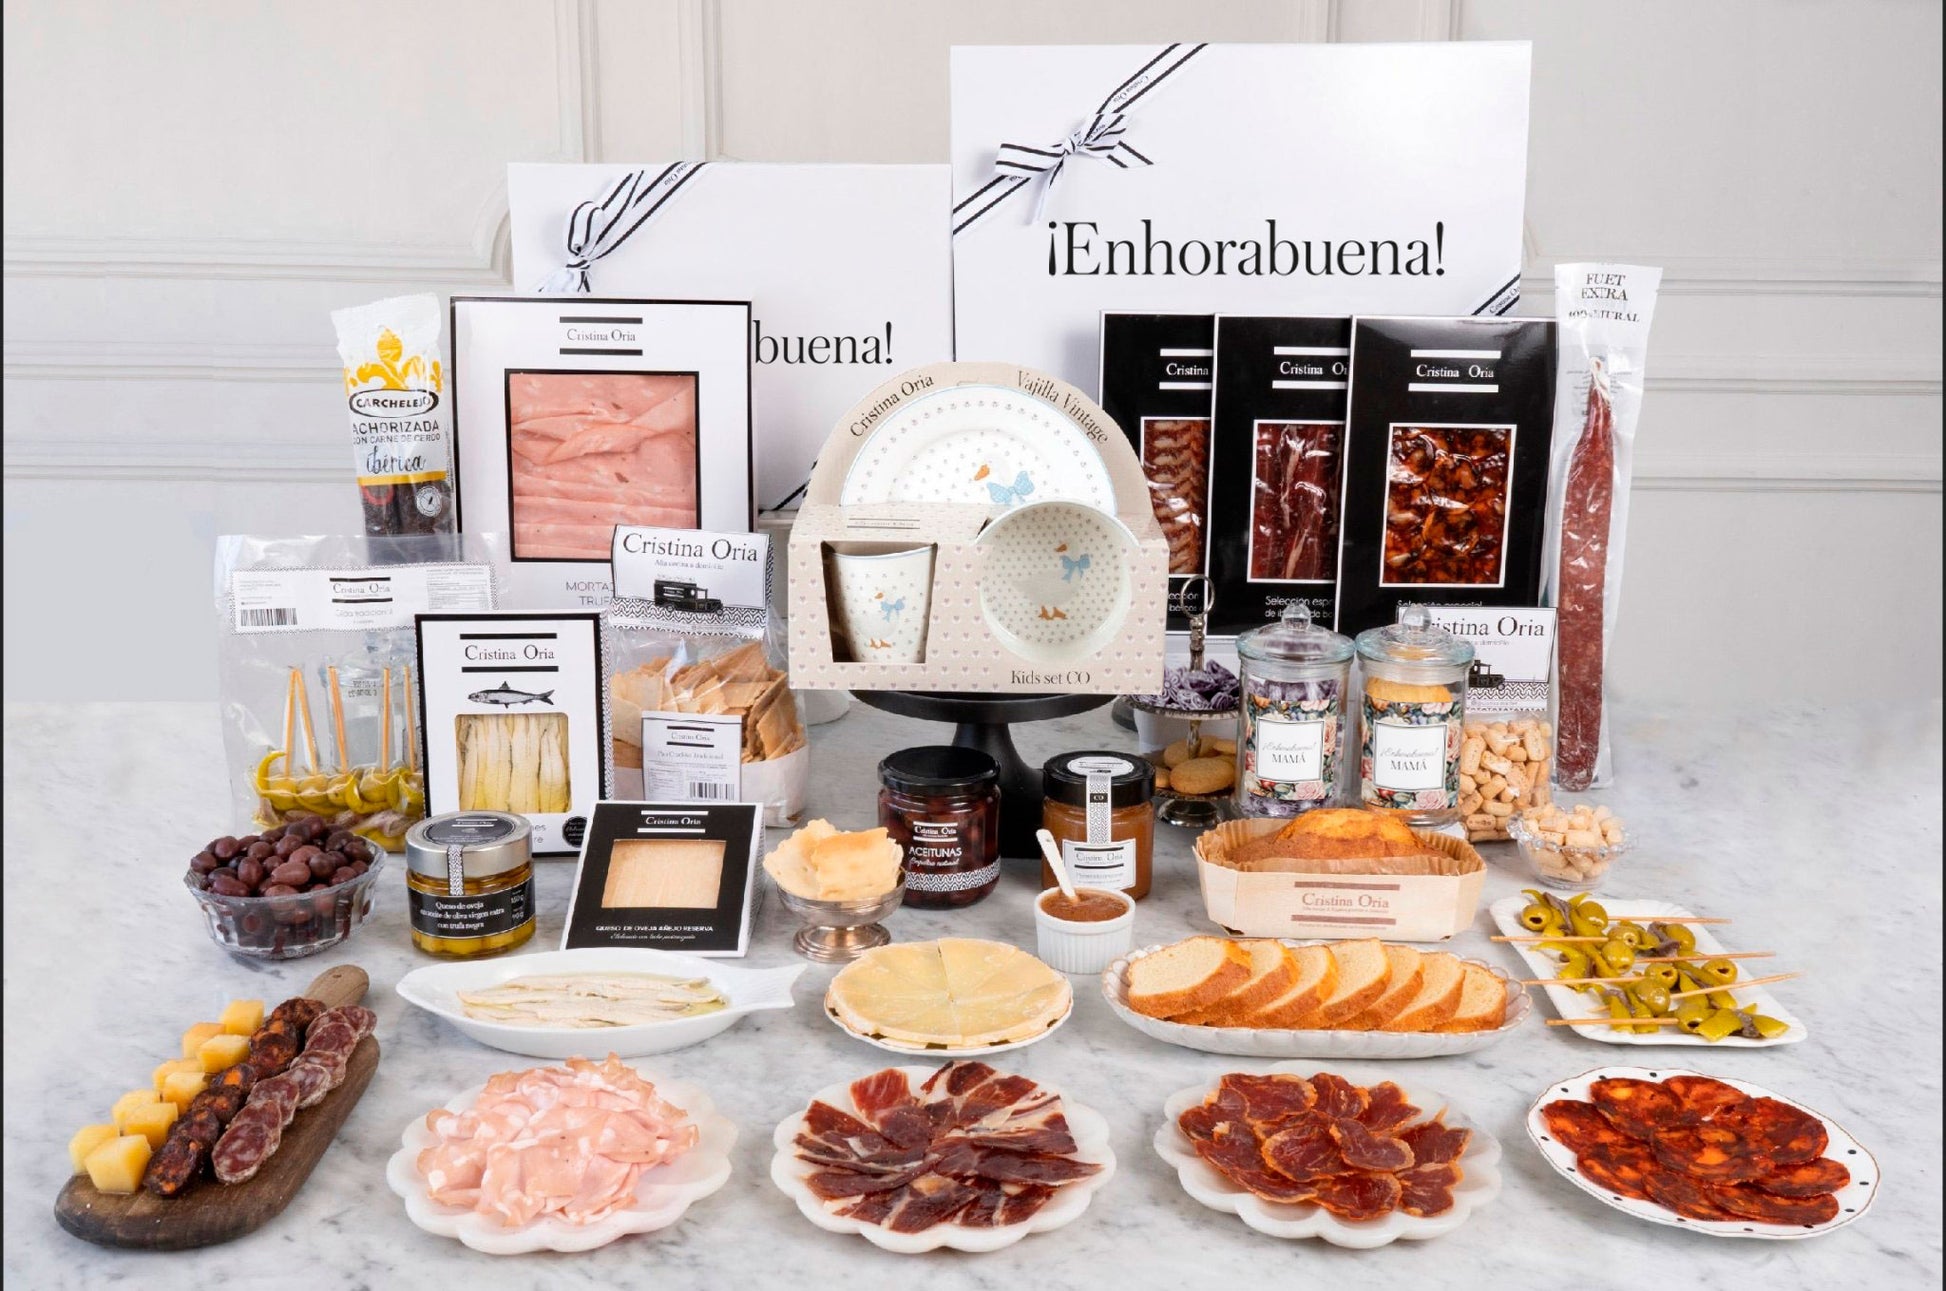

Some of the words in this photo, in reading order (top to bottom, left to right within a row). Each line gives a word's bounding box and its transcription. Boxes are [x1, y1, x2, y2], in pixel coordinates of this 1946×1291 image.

[1048, 218, 1446, 277] ¡Enhorabuena!
[1586, 273, 1626, 287] FUET
[1581, 287, 1629, 301] EXTRA
[566, 328, 608, 342] Cristina
[611, 328, 636, 342] Oria
[1165, 362, 1208, 376] Cristina
[1279, 361, 1323, 375] Cristina
[1416, 363, 1460, 378] Cristina
[1468, 364, 1495, 378] Oria
[850, 393, 900, 437] Cristina
[901, 374, 934, 396] Oria
[1017, 370, 1059, 402] Vajilla
[1063, 393, 1108, 444] Vintage
[366, 446, 426, 474] ibérica
[623, 532, 703, 558] Cristina
[712, 538, 758, 562] Oria
[332, 582, 365, 594] Cristina
[369, 582, 391, 594] Oria
[1496, 615, 1545, 637] Oria
[464, 644, 516, 661] Cristina
[523, 643, 554, 660] Oria
[1010, 670, 1040, 684] Kids
[1044, 673, 1062, 685] set
[1066, 671, 1090, 684] CO
[1271, 751, 1306, 764] MAMÁ
[1390, 758, 1428, 771] MAMÁ
[645, 816, 679, 825] Cristina
[681, 816, 702, 825] Oria
[908, 846, 962, 857] ACEITUNAS
[1301, 892, 1353, 907] Cristina
[1358, 894, 1390, 909] Oria
